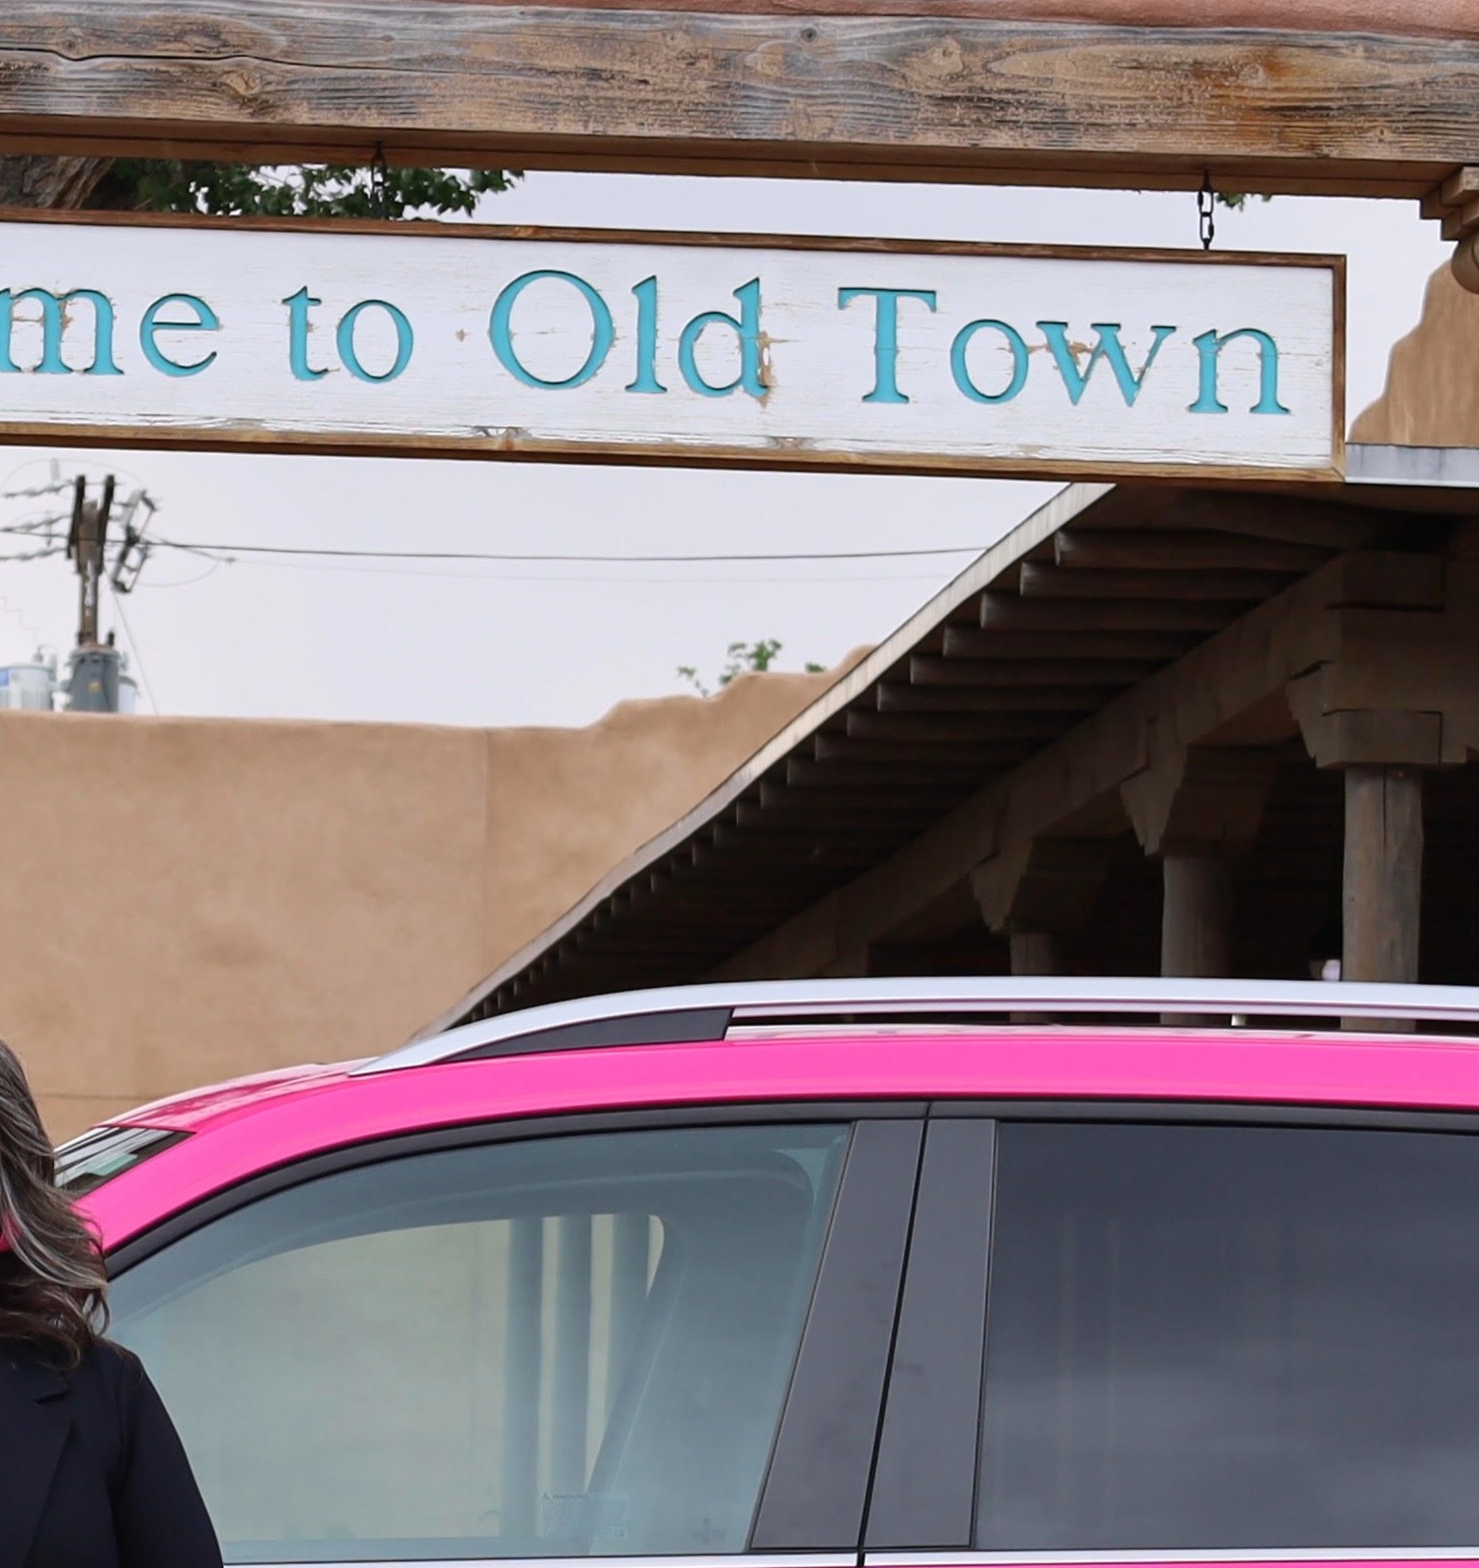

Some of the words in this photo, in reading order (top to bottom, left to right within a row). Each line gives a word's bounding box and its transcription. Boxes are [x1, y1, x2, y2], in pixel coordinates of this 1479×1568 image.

[287, 288, 415, 384] to
[489, 271, 769, 398] Old
[837, 286, 1289, 416] Town
